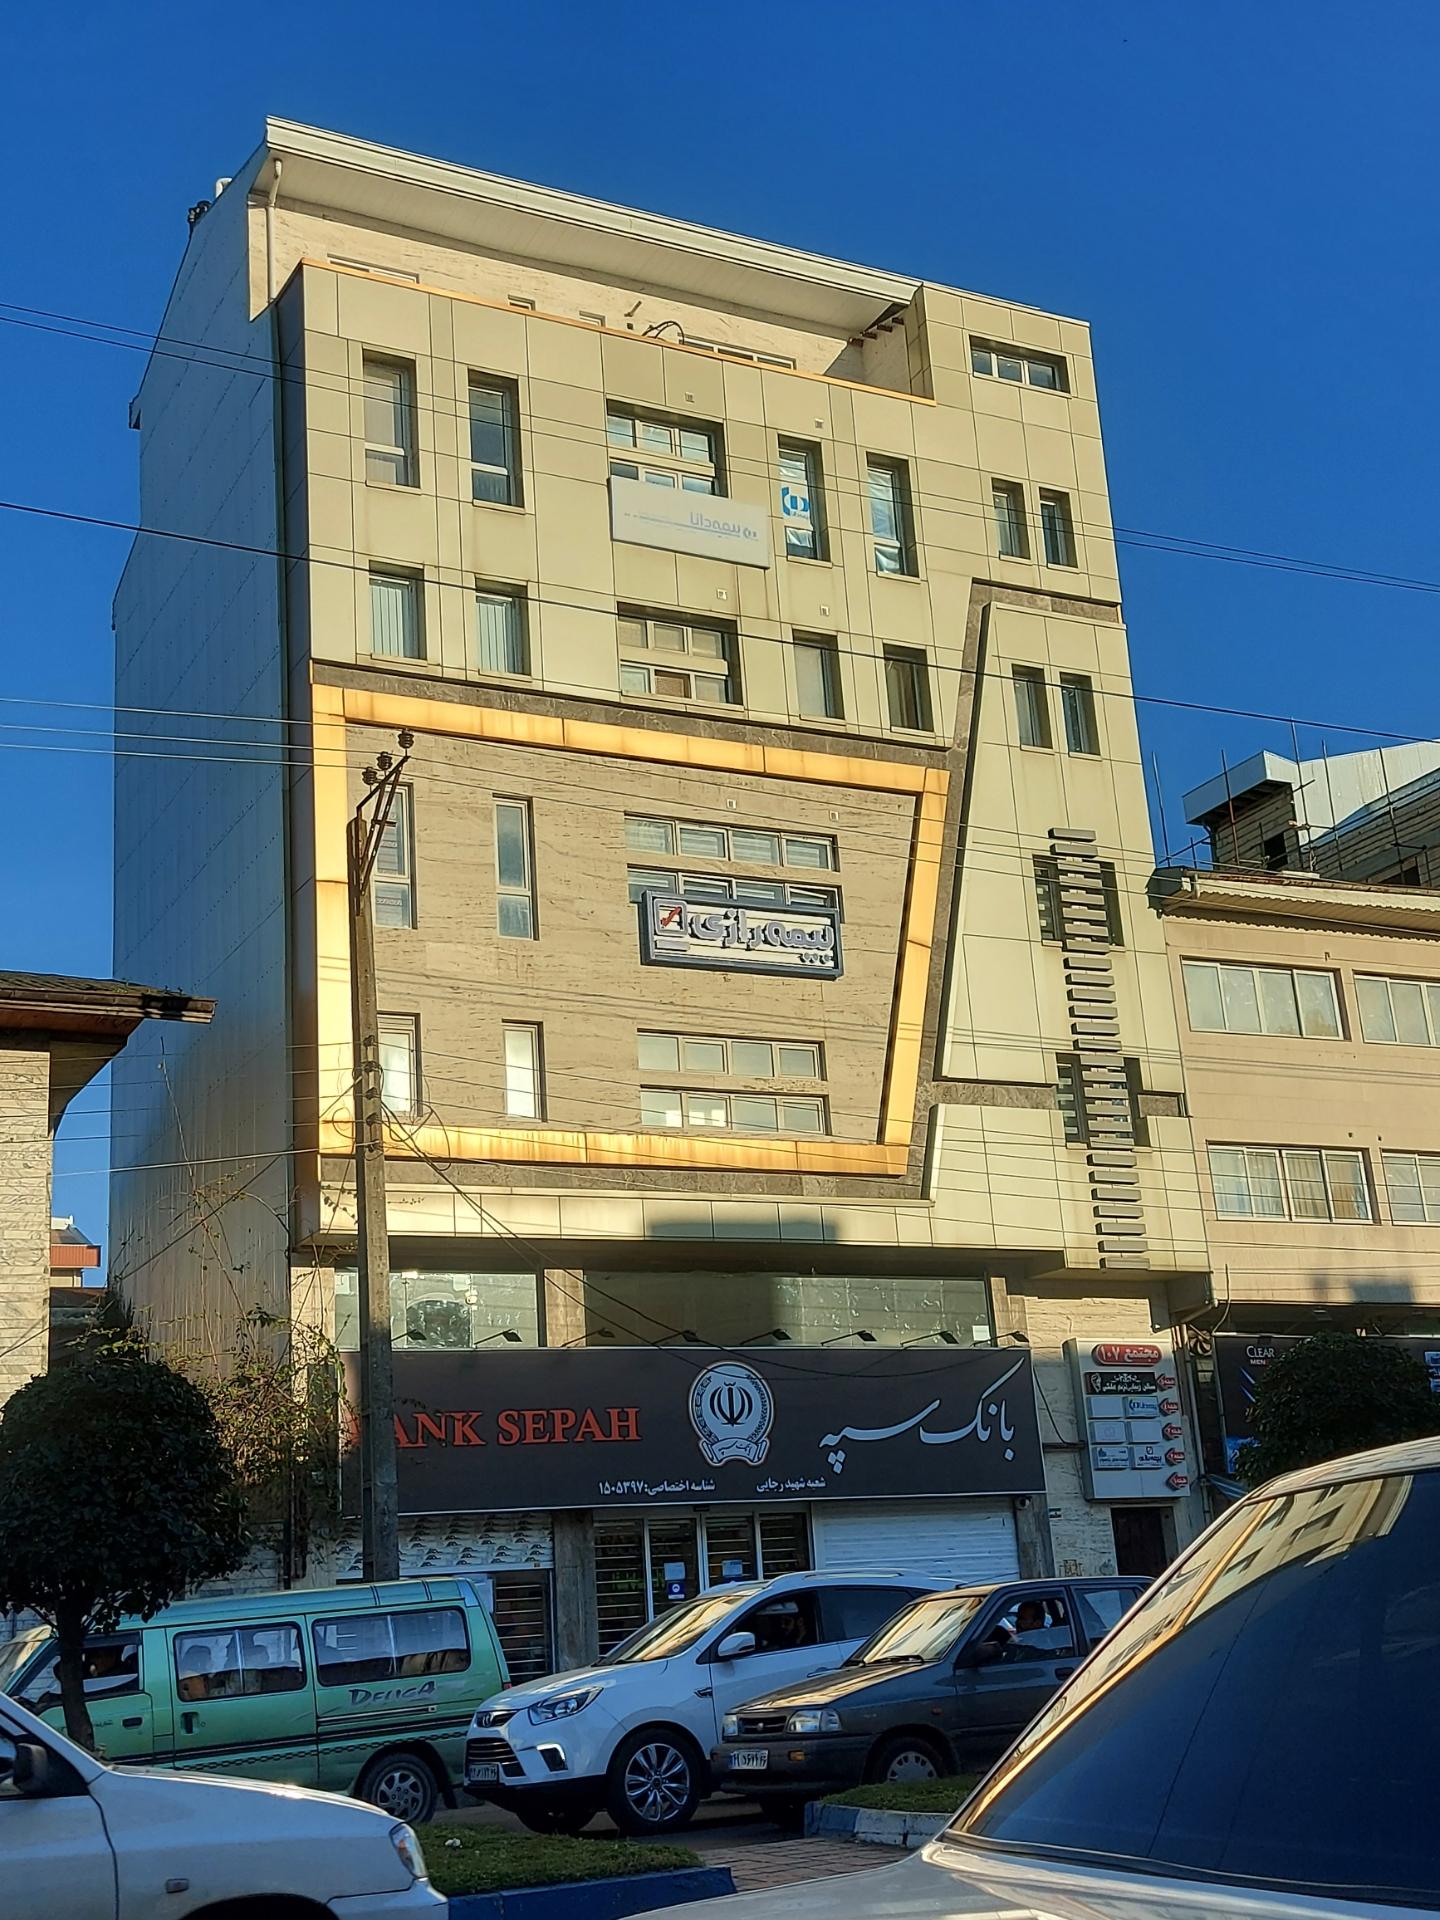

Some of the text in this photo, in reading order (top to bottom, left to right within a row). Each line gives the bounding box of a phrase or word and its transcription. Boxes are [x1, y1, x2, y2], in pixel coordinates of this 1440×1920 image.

[689, 908, 835, 964] بیمه رازی
[1101, 1346, 1159, 1363] مجتمع ۱۰۷
[819, 1355, 1026, 1475] بانک سپه
[348, 1406, 643, 1448] ANK SEPAH
[690, 1478, 716, 1492] شناسه
[785, 1477, 807, 1489] شهید
[806, 1475, 827, 1488] شعبه
